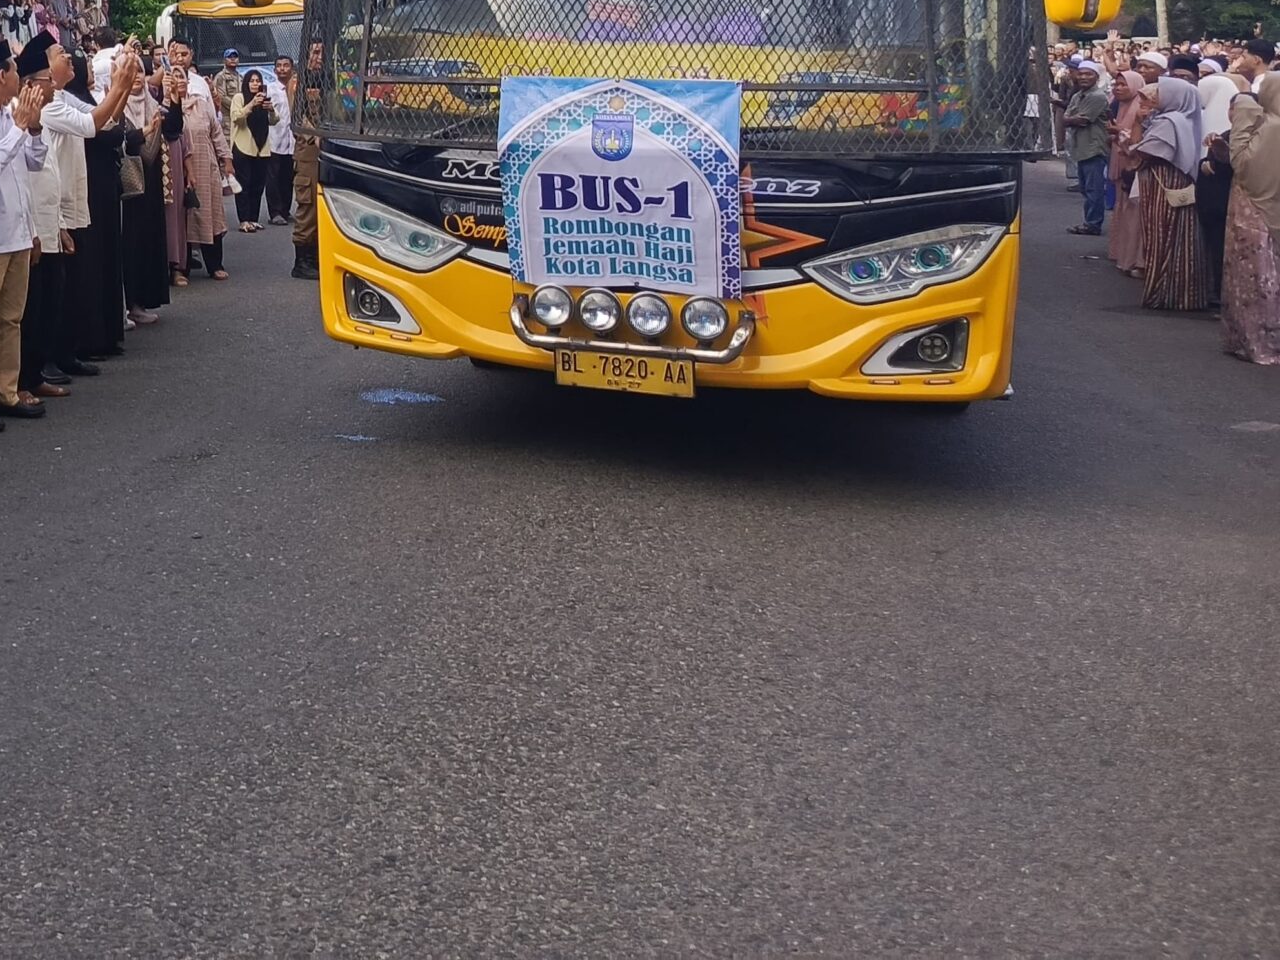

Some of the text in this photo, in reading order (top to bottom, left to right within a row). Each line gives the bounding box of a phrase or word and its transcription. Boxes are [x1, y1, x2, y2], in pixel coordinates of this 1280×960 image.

[537, 172, 693, 220] BUS-1
[542, 216, 692, 244] Rombongan
[543, 237, 694, 265] Jemaah Haji
[544, 256, 694, 284] Kota Langsa
[561, 351, 584, 374] BL
[663, 362, 687, 385] AA
